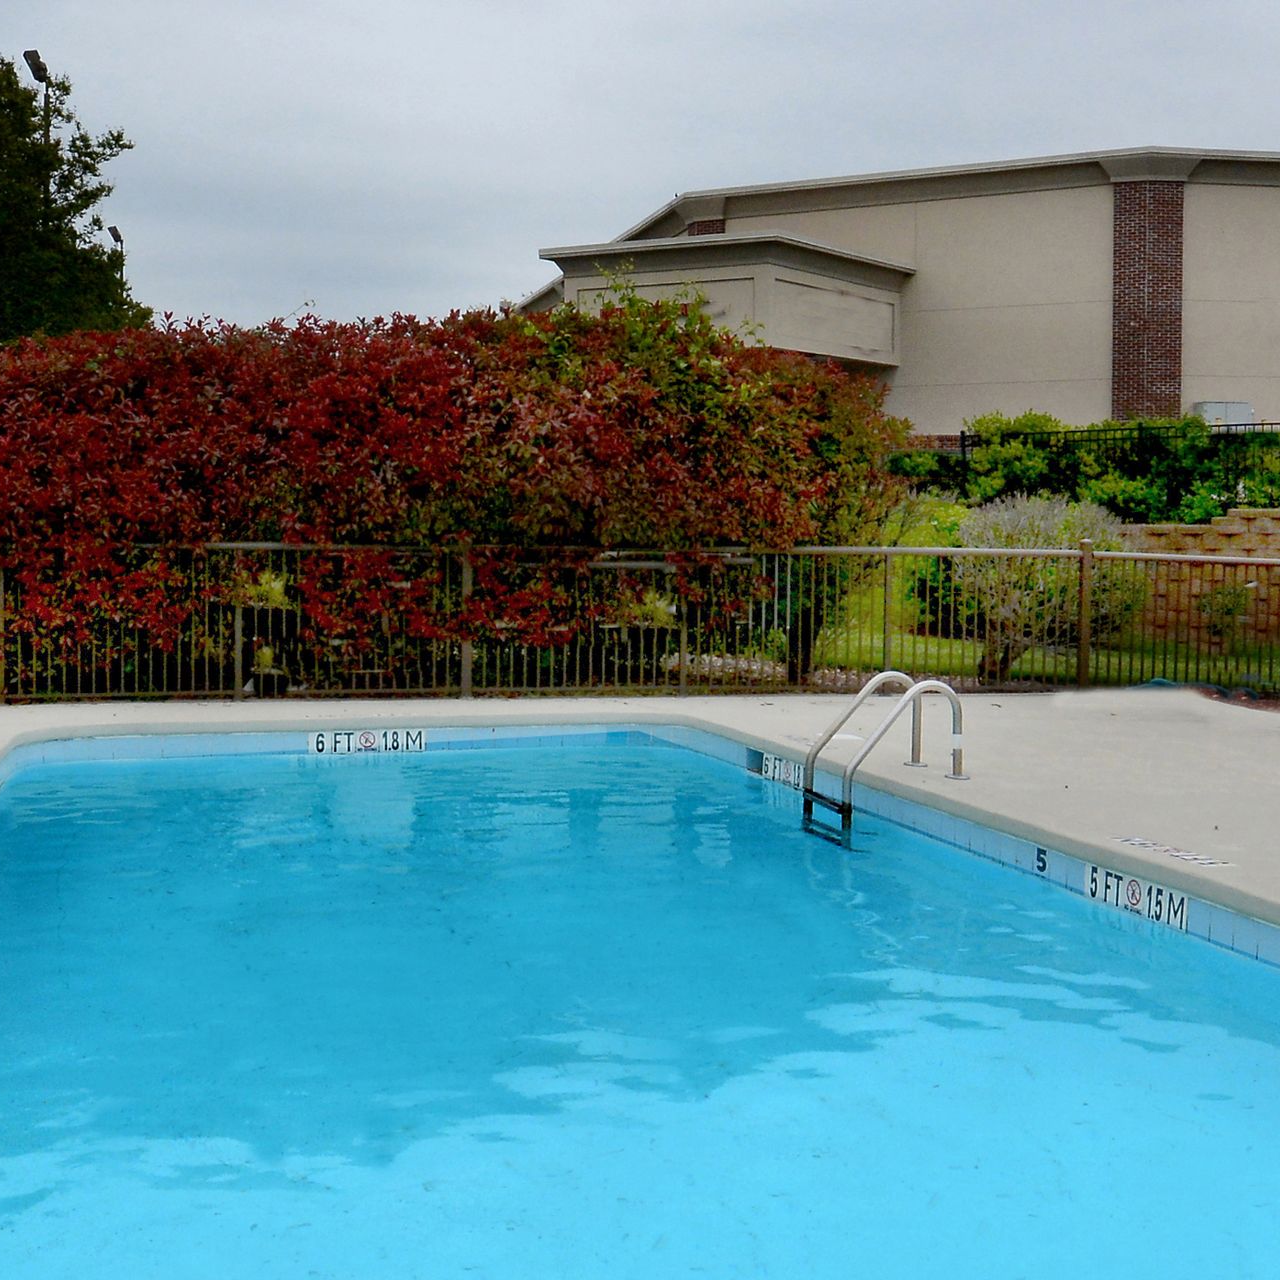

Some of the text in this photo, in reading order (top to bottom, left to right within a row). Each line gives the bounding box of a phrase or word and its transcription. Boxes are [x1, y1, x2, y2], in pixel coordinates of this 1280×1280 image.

[315, 730, 422, 752] 6 FT 1.8 M
[764, 757, 769, 774] 6
[1036, 847, 1047, 873] 5
[1090, 866, 1185, 930] 5 FT 1.5 M
